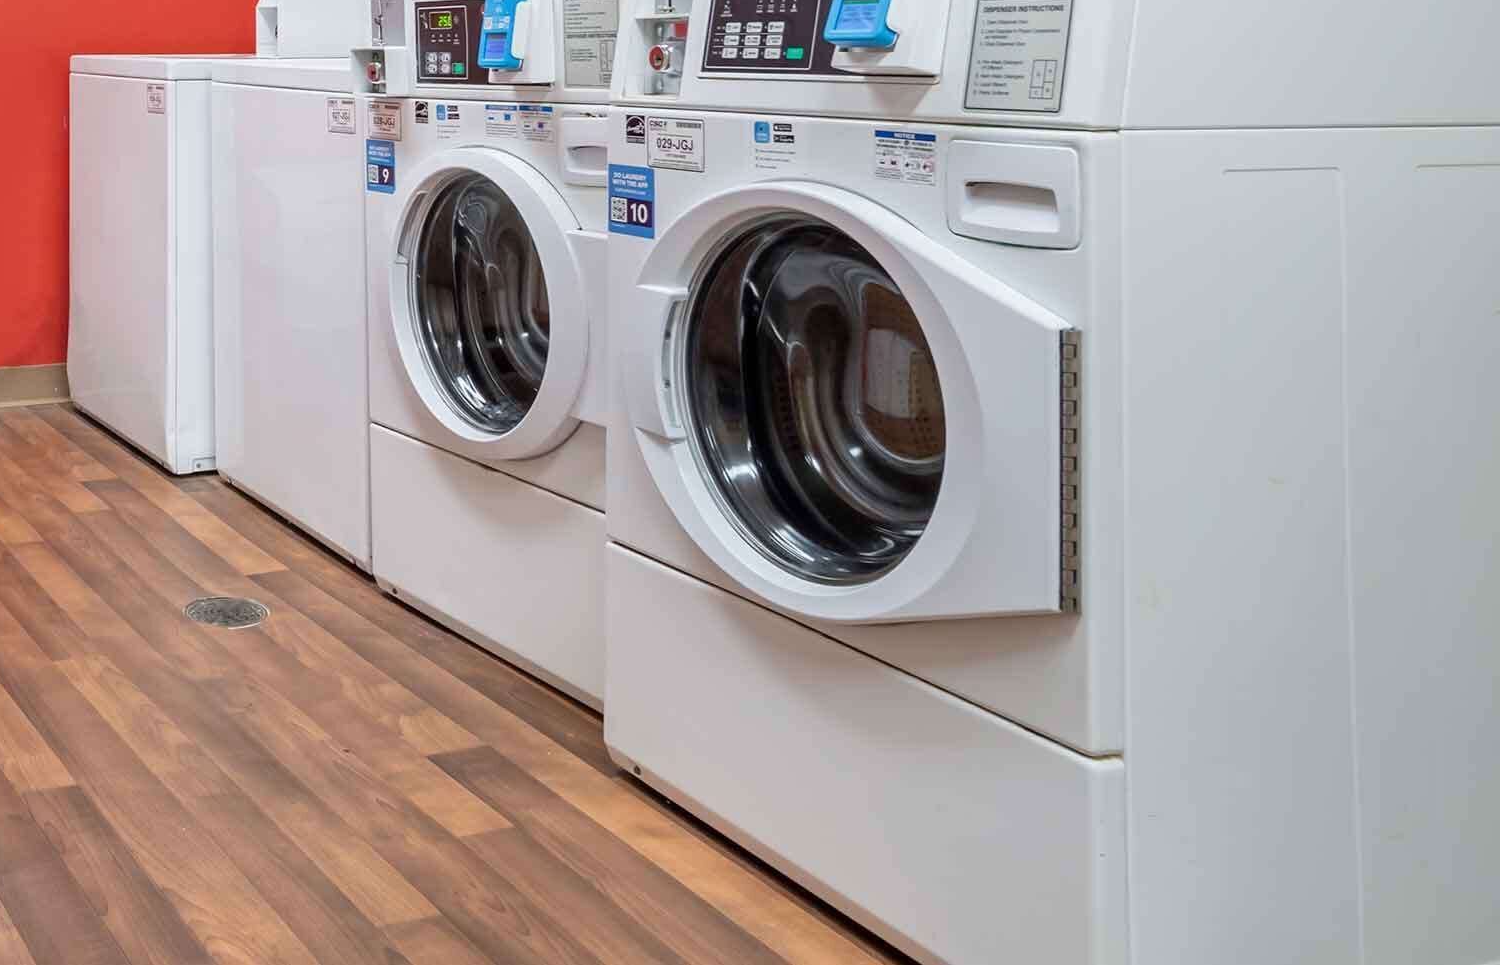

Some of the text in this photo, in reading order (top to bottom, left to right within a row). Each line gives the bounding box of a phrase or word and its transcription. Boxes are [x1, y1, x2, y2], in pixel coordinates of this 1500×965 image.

[983, 4, 1064, 13] DISPENSER INSTRUCTIONS
[656, 137, 694, 151] 029-JGJ
[382, 168, 389, 183] 9
[630, 203, 648, 223] 10
